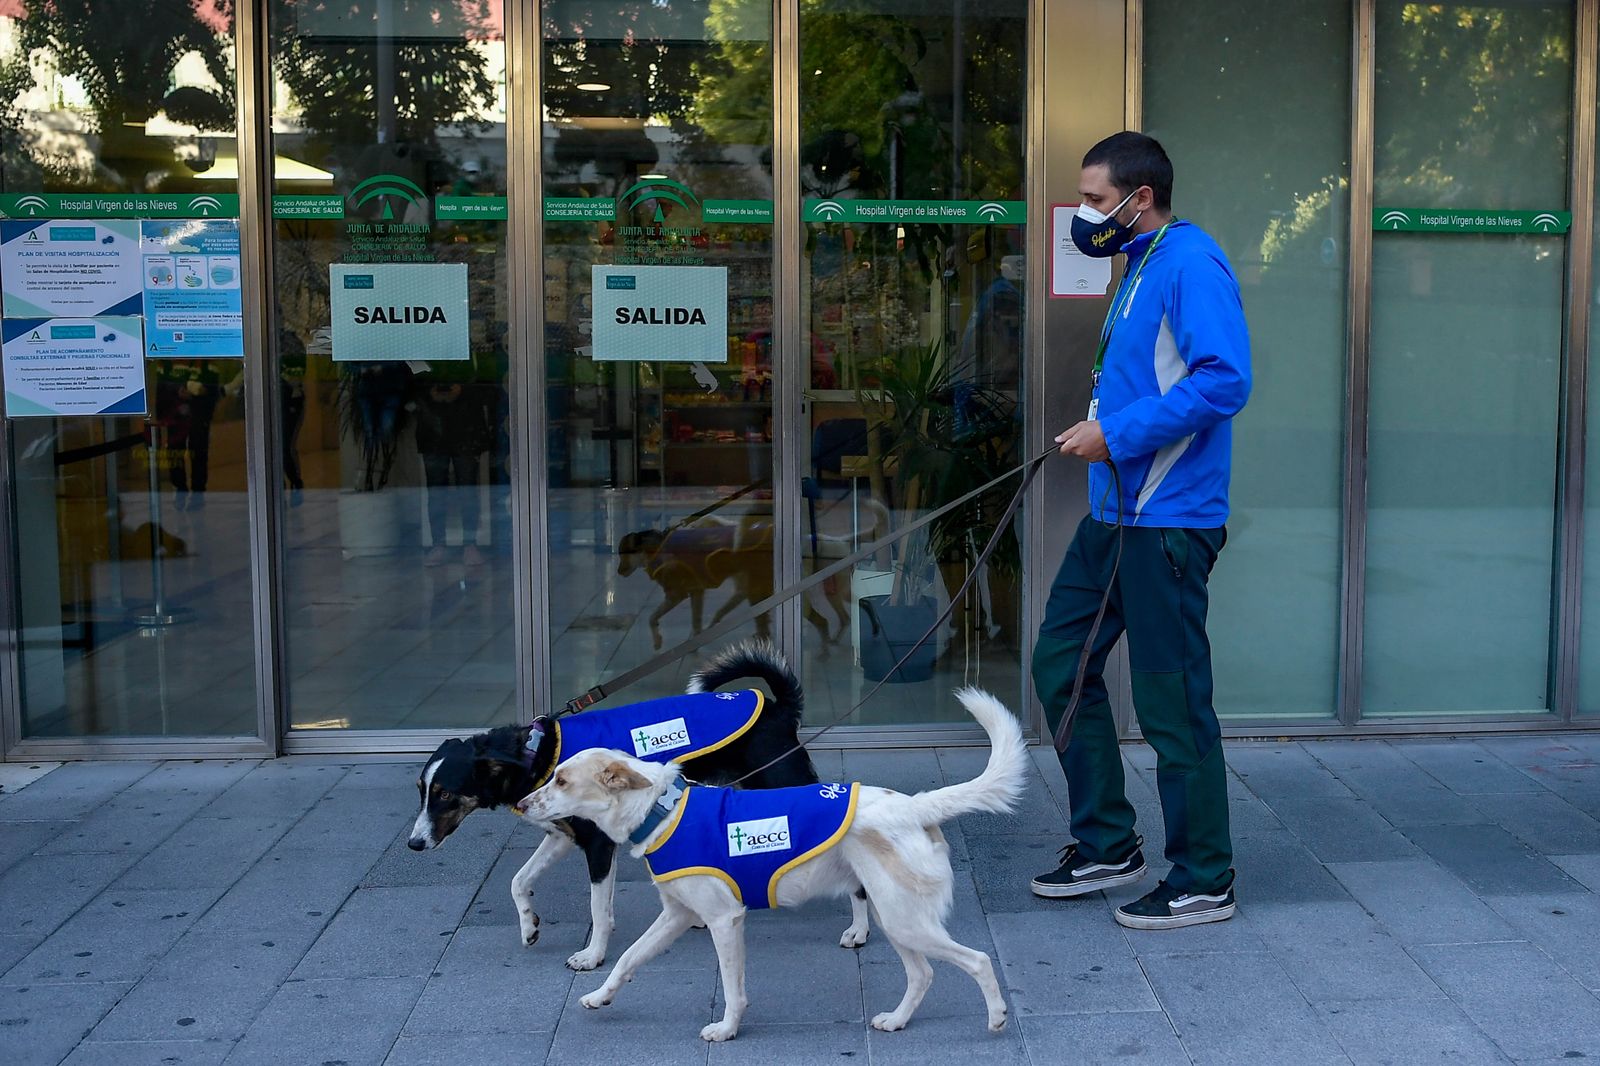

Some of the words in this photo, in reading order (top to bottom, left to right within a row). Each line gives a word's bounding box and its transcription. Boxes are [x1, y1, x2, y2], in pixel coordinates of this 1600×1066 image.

[60, 200, 93, 211] Hospital
[95, 200, 122, 212] Virgen
[123, 200, 134, 210] de
[136, 200, 148, 210] las
[150, 201, 178, 210] Nieves
[856, 205, 886, 216] Hospital
[888, 206, 913, 217] Virgen
[916, 205, 925, 215] de
[927, 206, 938, 215] las
[940, 206, 966, 216] Nieves
[1420, 215, 1449, 226] Hospital
[1451, 216, 1474, 227] Virgen
[1475, 216, 1484, 226] de
[1486, 216, 1497, 226] las
[1498, 217, 1522, 226] Nieves
[346, 224, 371, 233] JUNTA
[375, 224, 384, 233] DE
[618, 226, 642, 236] JUNTA
[646, 226, 655, 236] DE
[354, 307, 447, 324] SALIDA
[615, 307, 707, 325] SALIDA
[650, 730, 686, 746] aecc
[747, 831, 788, 846] aecc
